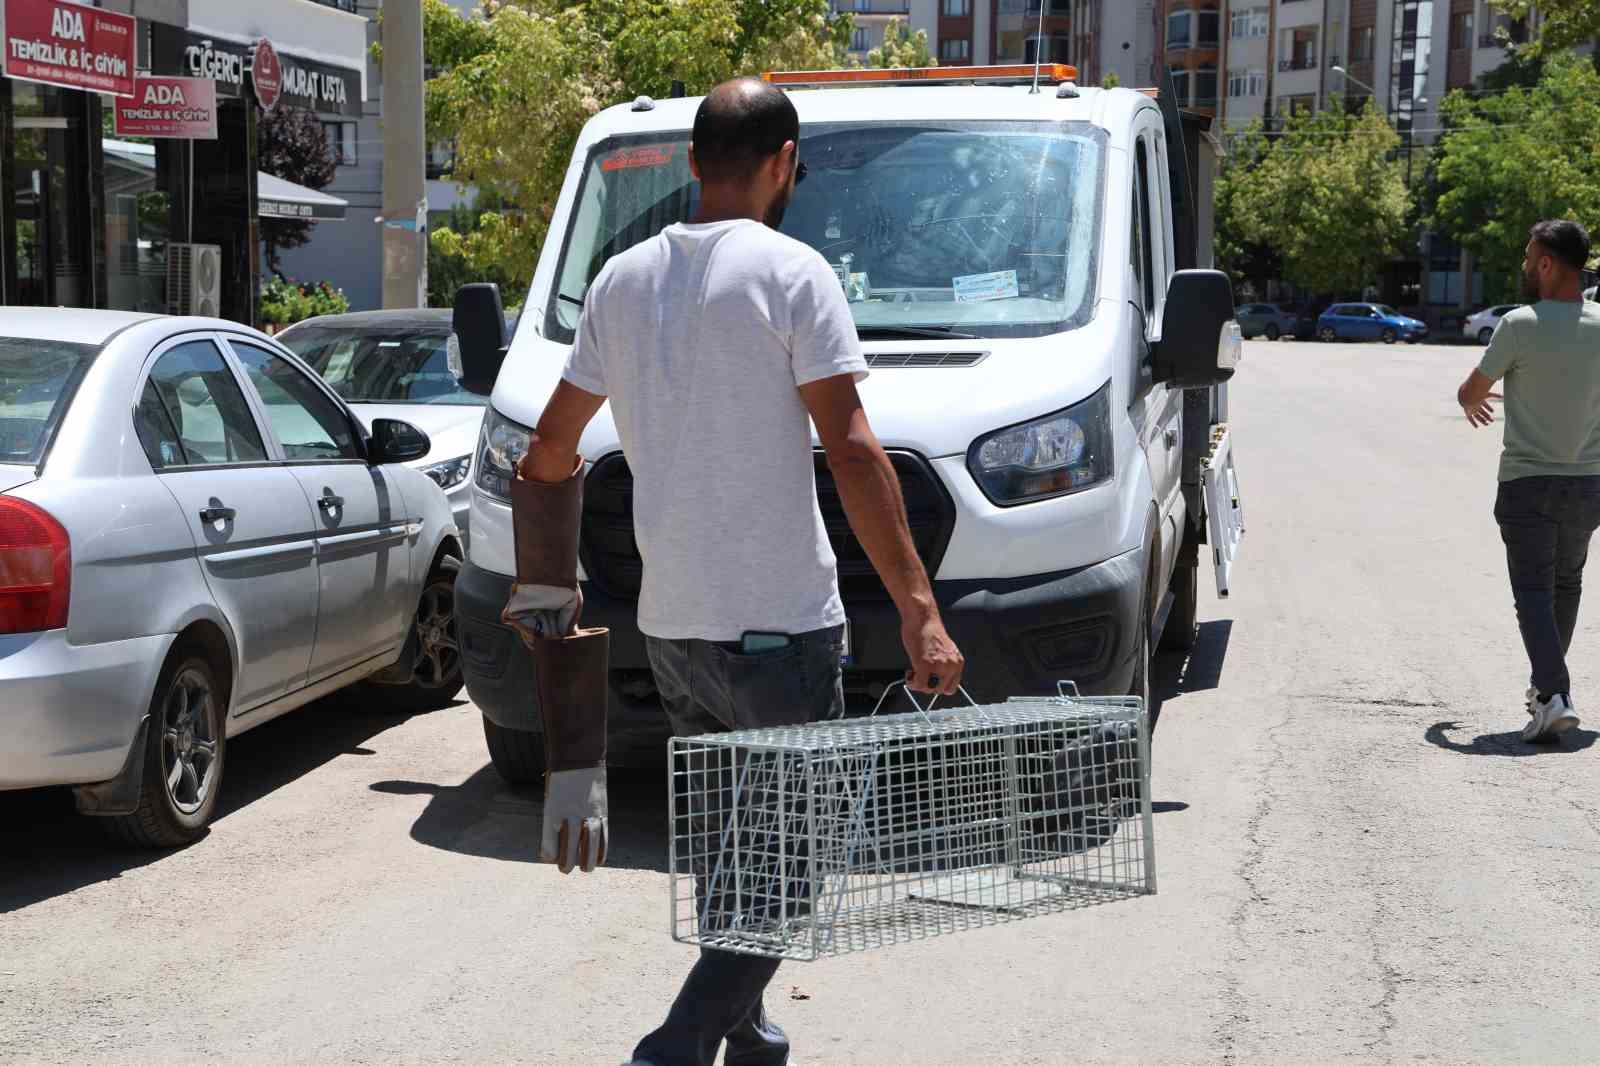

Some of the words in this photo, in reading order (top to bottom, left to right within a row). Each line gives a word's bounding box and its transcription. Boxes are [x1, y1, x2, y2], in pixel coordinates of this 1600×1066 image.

[51, 8, 85, 41] ADA
[9, 38, 67, 66] TEMİZLİK
[69, 48, 79, 67] &
[80, 47, 93, 73] İÇ
[95, 52, 127, 77] GİYİM
[143, 84, 186, 105] ADA
[282, 67, 319, 99] MURAT
[320, 75, 347, 105] USTA
